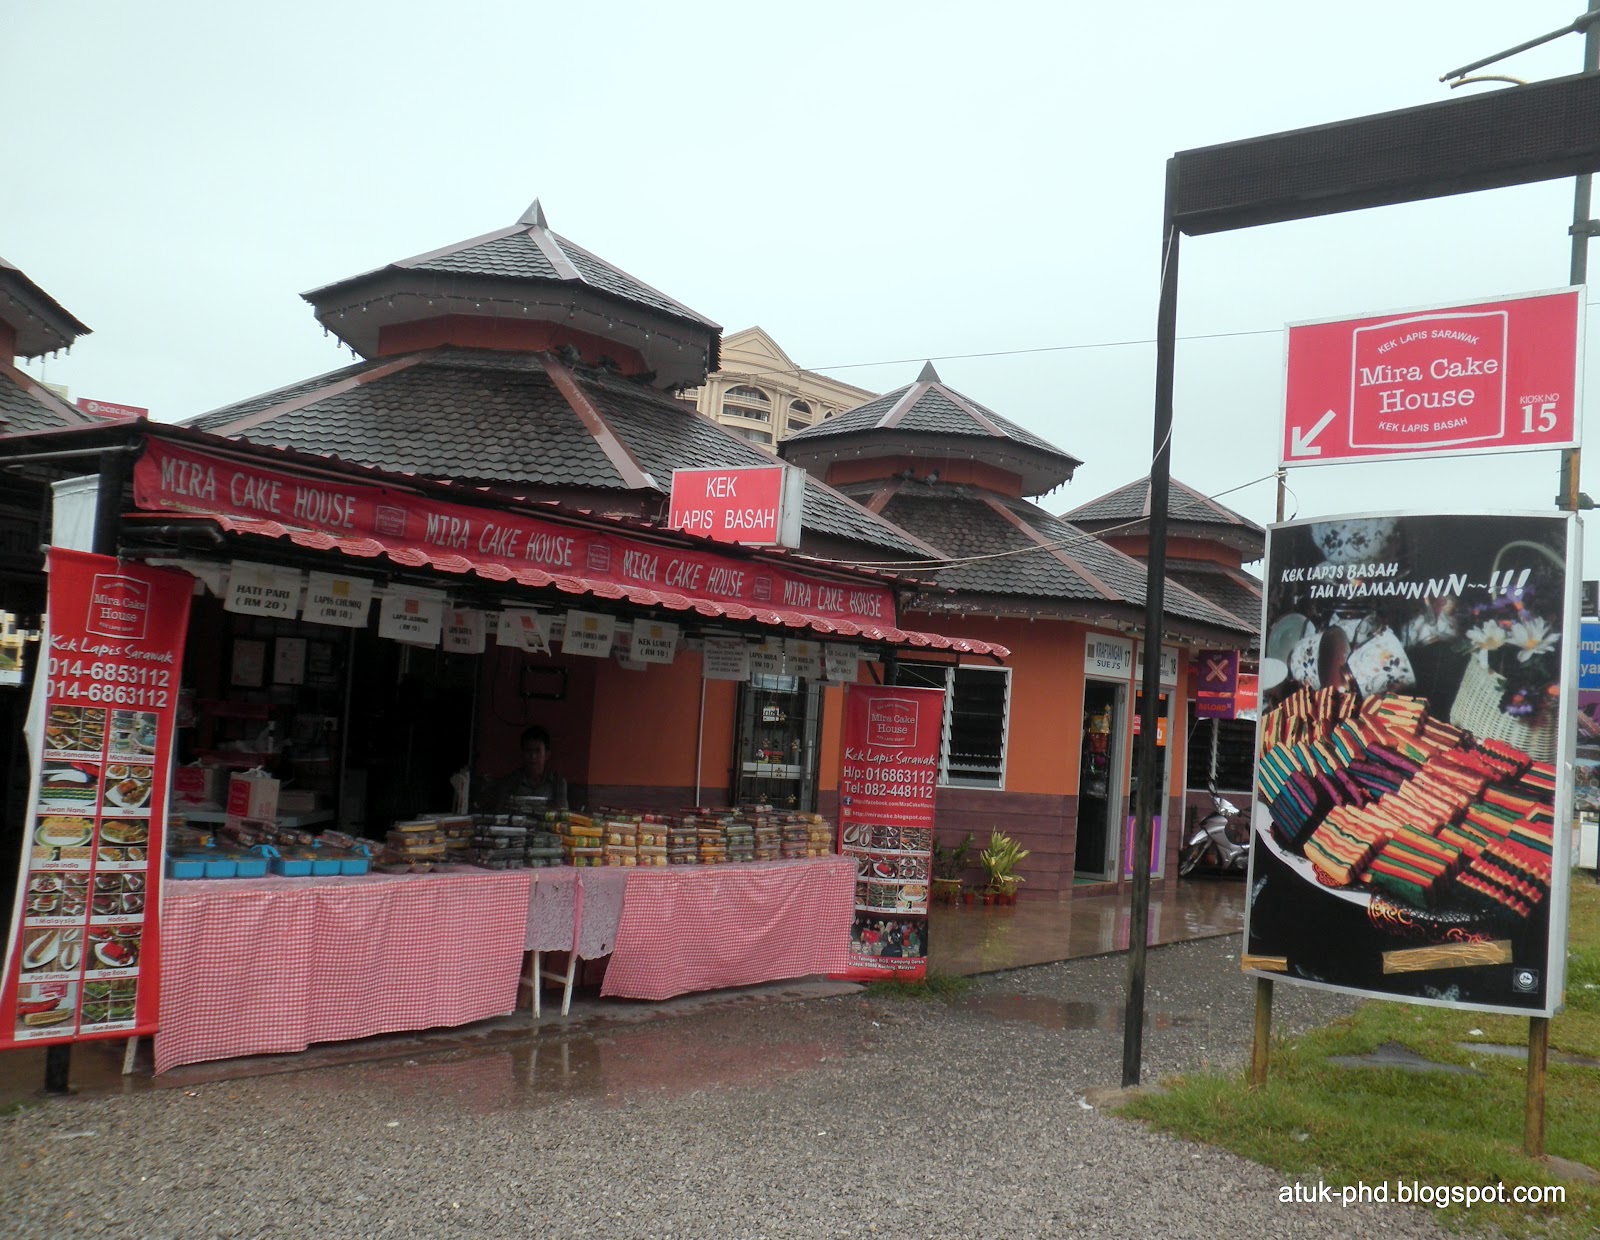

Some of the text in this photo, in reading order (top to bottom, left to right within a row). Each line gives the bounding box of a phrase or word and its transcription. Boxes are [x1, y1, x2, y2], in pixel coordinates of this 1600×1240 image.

[1378, 329, 1479, 354] KEK LAPIS SARAWAK
[1360, 357, 1498, 386] Mira Cake
[1379, 388, 1475, 413] House
[1520, 393, 1559, 404] KIOSK NO
[99, 405, 139, 417] OCBC Bank
[1521, 403, 1557, 434] 15
[1379, 416, 1468, 432] KEK LAPIS BASAH
[161, 456, 216, 501] MIRA
[230, 472, 282, 514] CAKE
[294, 486, 356, 528] HOUSE
[706, 476, 738, 498] KEK
[674, 508, 774, 529] LAPIS BASAH
[425, 512, 574, 567] MIRA CAKE HOUSE
[623, 550, 659, 582] MIRA
[665, 559, 703, 590] CAKE
[706, 567, 744, 597] HOUSE
[1281, 562, 1398, 583] KEK LAPIS BASAH
[236, 585, 290, 599] HATI PARI
[314, 595, 334, 605] LAPIS
[784, 580, 811, 607] MIRA
[817, 586, 844, 611] CAKE
[850, 591, 882, 618] HOUSE
[1310, 585, 1334, 599] TAU
[94, 594, 146, 611] Mira Cake
[100, 607, 137, 622] House
[392, 613, 429, 624] LAPIS JASMINE
[50, 634, 174, 664] Kek Lapis Sarawak
[638, 638, 651, 647] KEK
[1097, 660, 1110, 668] SUE
[1124, 650, 1131, 668] 17
[48, 658, 170, 688] 014-6853112
[46, 680, 168, 708] 014-6863112
[871, 713, 915, 724] Mira Cake
[877, 723, 908, 734] House
[845, 747, 935, 767] Kek Lapis Sarawak
[843, 766, 934, 784] H/p: 016863112
[844, 781, 933, 799] Tel: 082-448112
